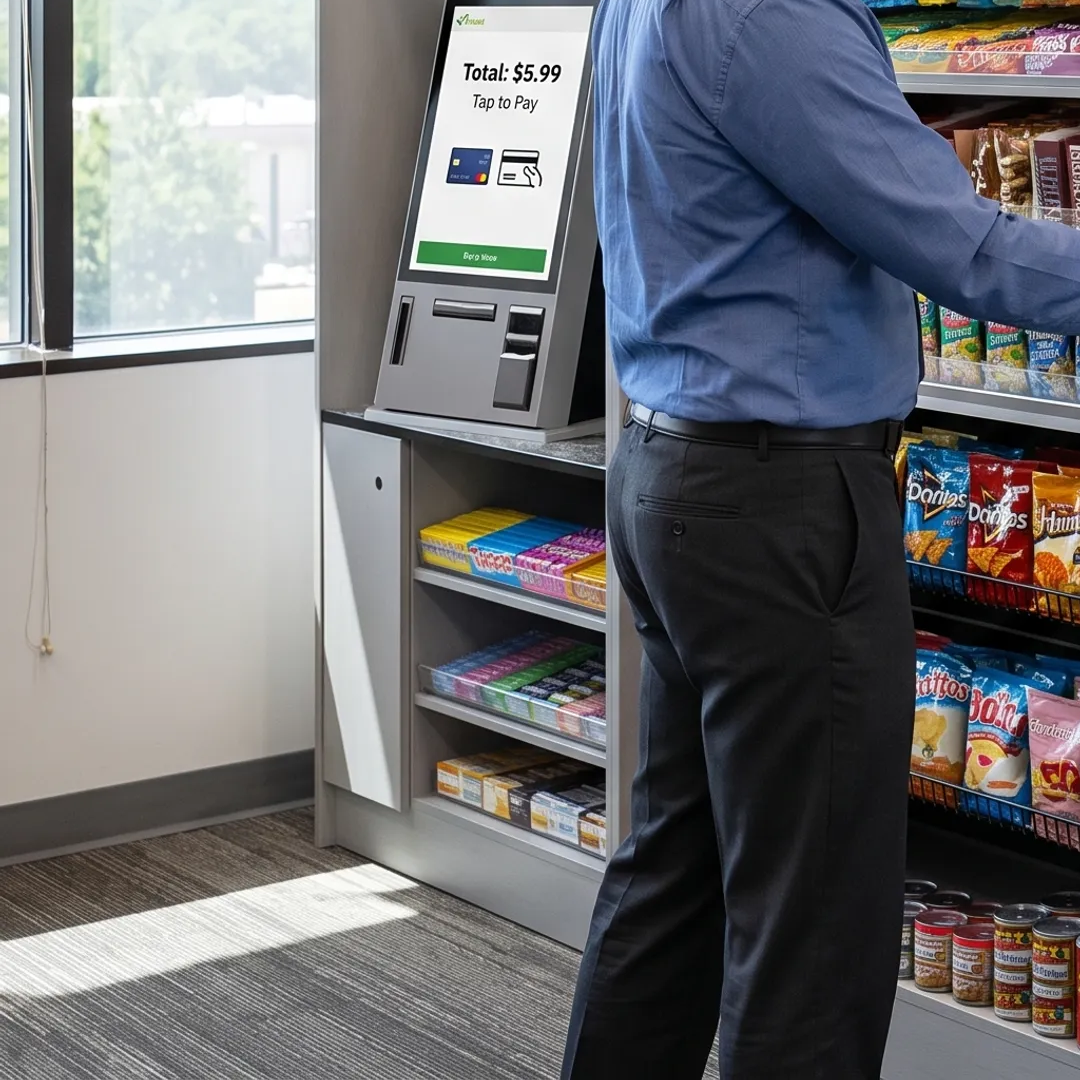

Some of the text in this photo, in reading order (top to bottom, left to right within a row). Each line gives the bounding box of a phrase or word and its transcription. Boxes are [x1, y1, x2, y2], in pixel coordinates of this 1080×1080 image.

[463, 61, 562, 85] Total: $5.99
[473, 93, 539, 114] Tap to Pay
